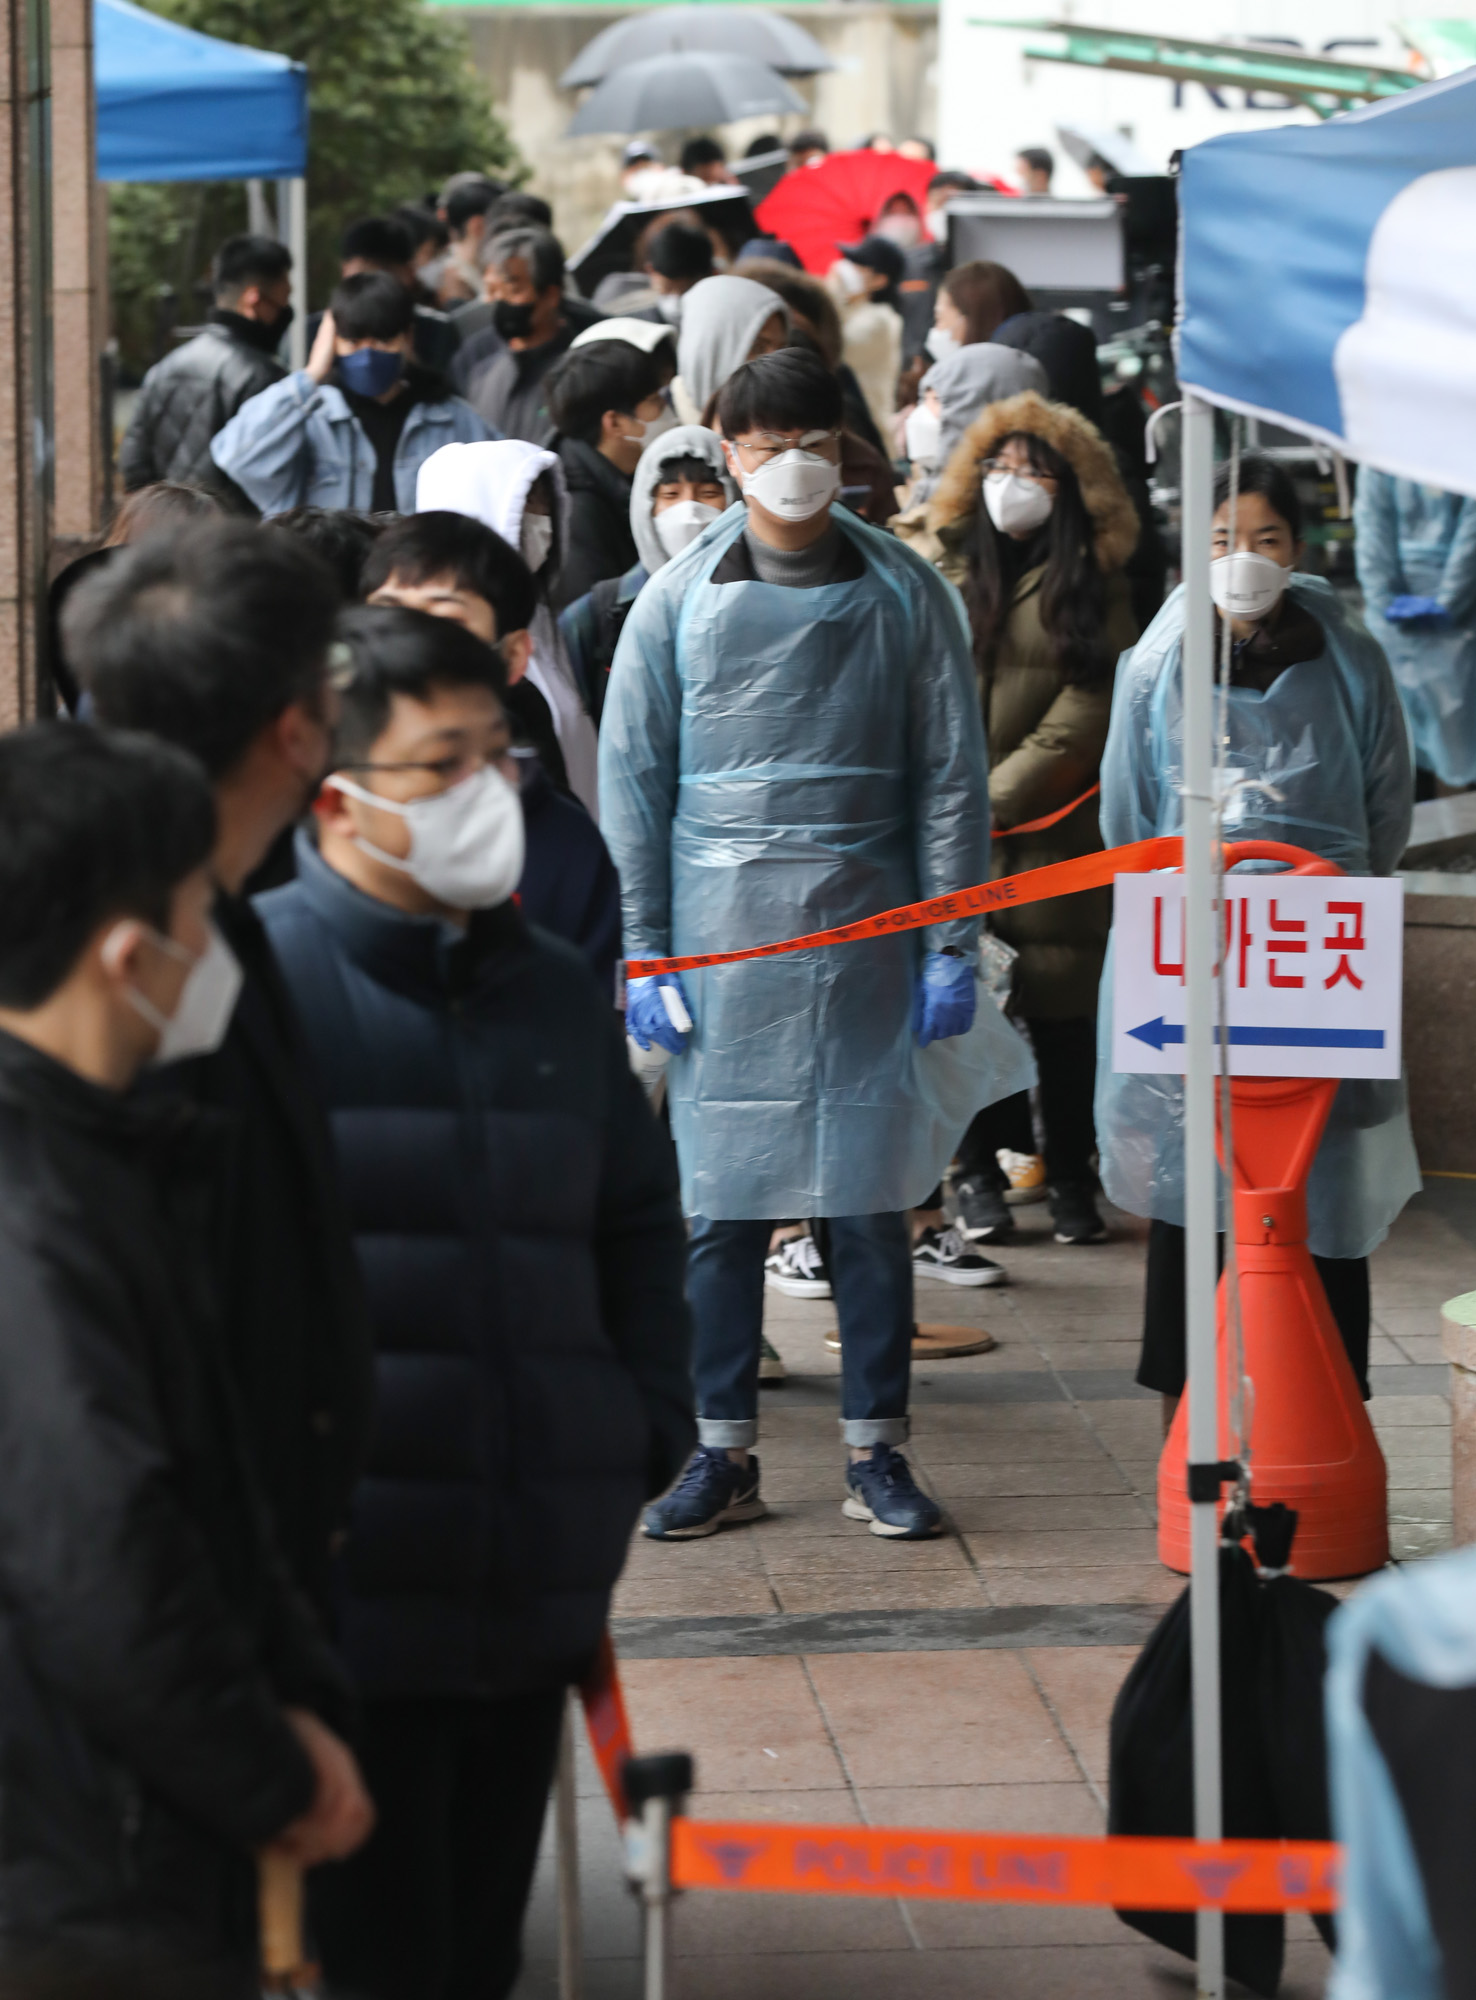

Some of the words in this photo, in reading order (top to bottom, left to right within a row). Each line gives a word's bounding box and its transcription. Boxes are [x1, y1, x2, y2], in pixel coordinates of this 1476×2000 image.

[874, 898, 958, 930] POLICE
[965, 881, 1019, 909] LINE
[794, 1841, 952, 1889] POLICE
[970, 1849, 1069, 1895] LINE
